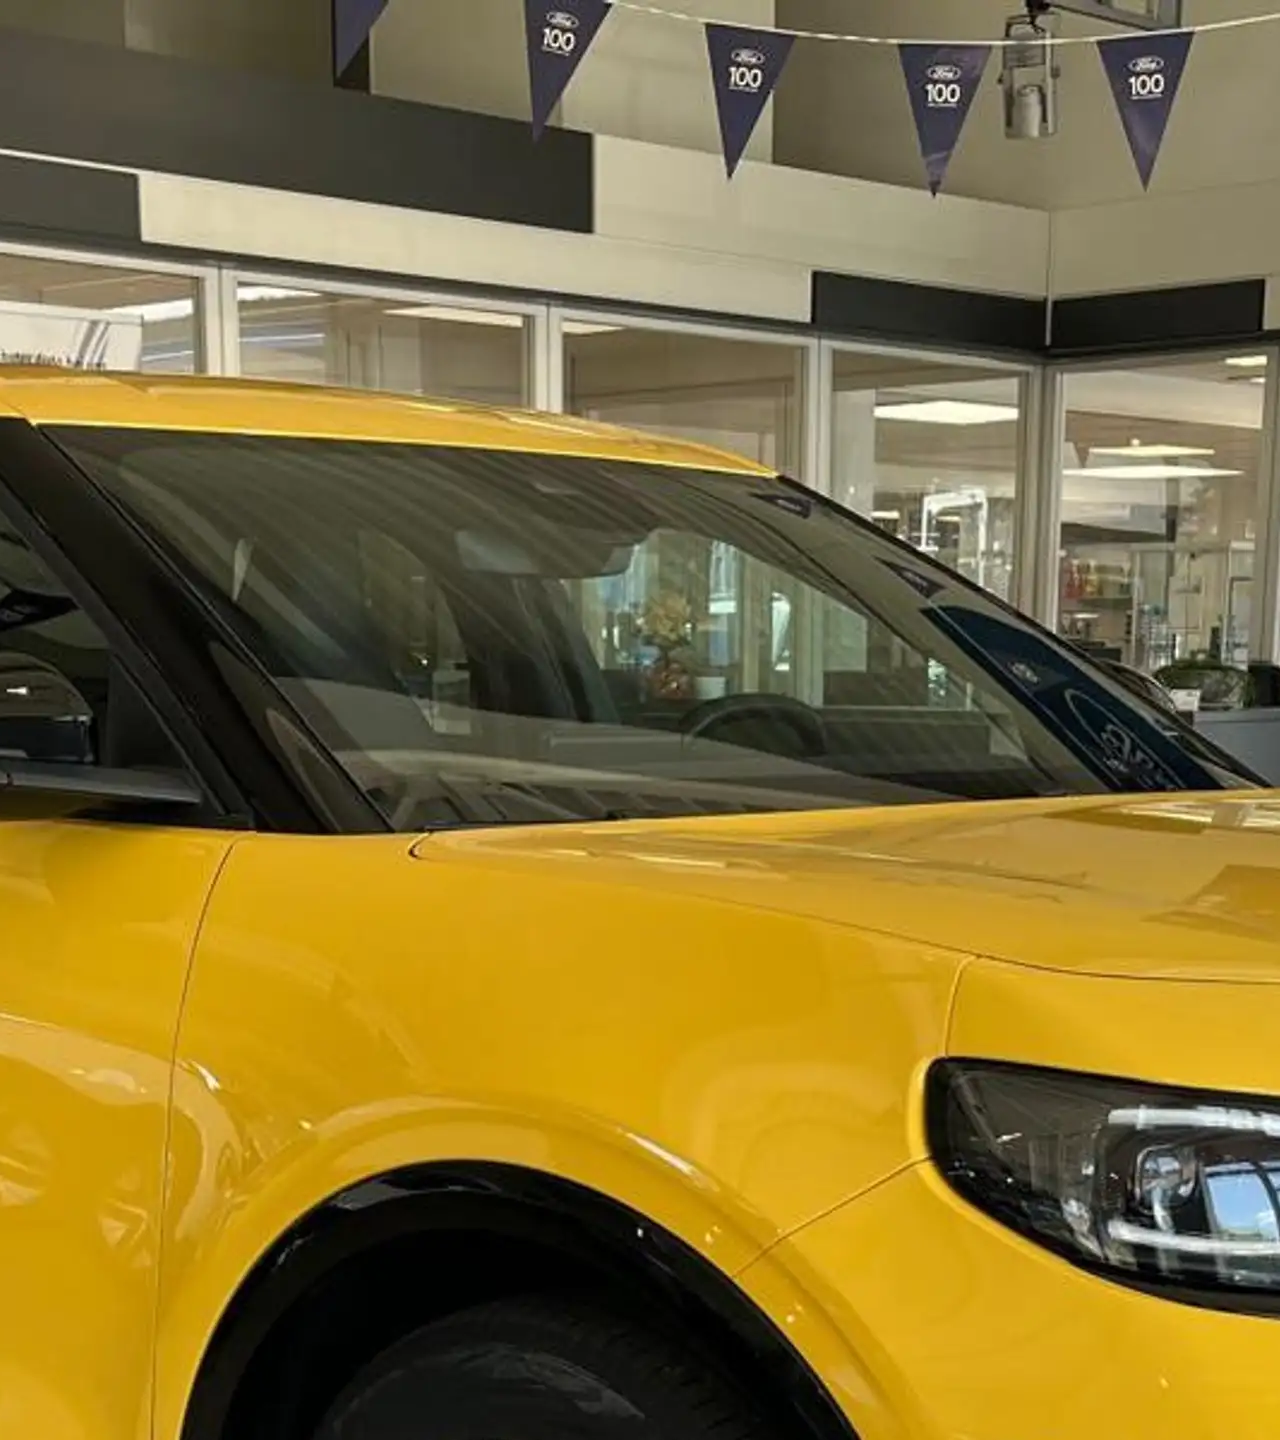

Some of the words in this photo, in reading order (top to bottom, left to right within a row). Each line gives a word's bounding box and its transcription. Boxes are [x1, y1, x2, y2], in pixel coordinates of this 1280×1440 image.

[543, 28, 575, 51] 100
[729, 66, 762, 88] 100
[1129, 74, 1165, 95] 100
[925, 84, 960, 102] 100
